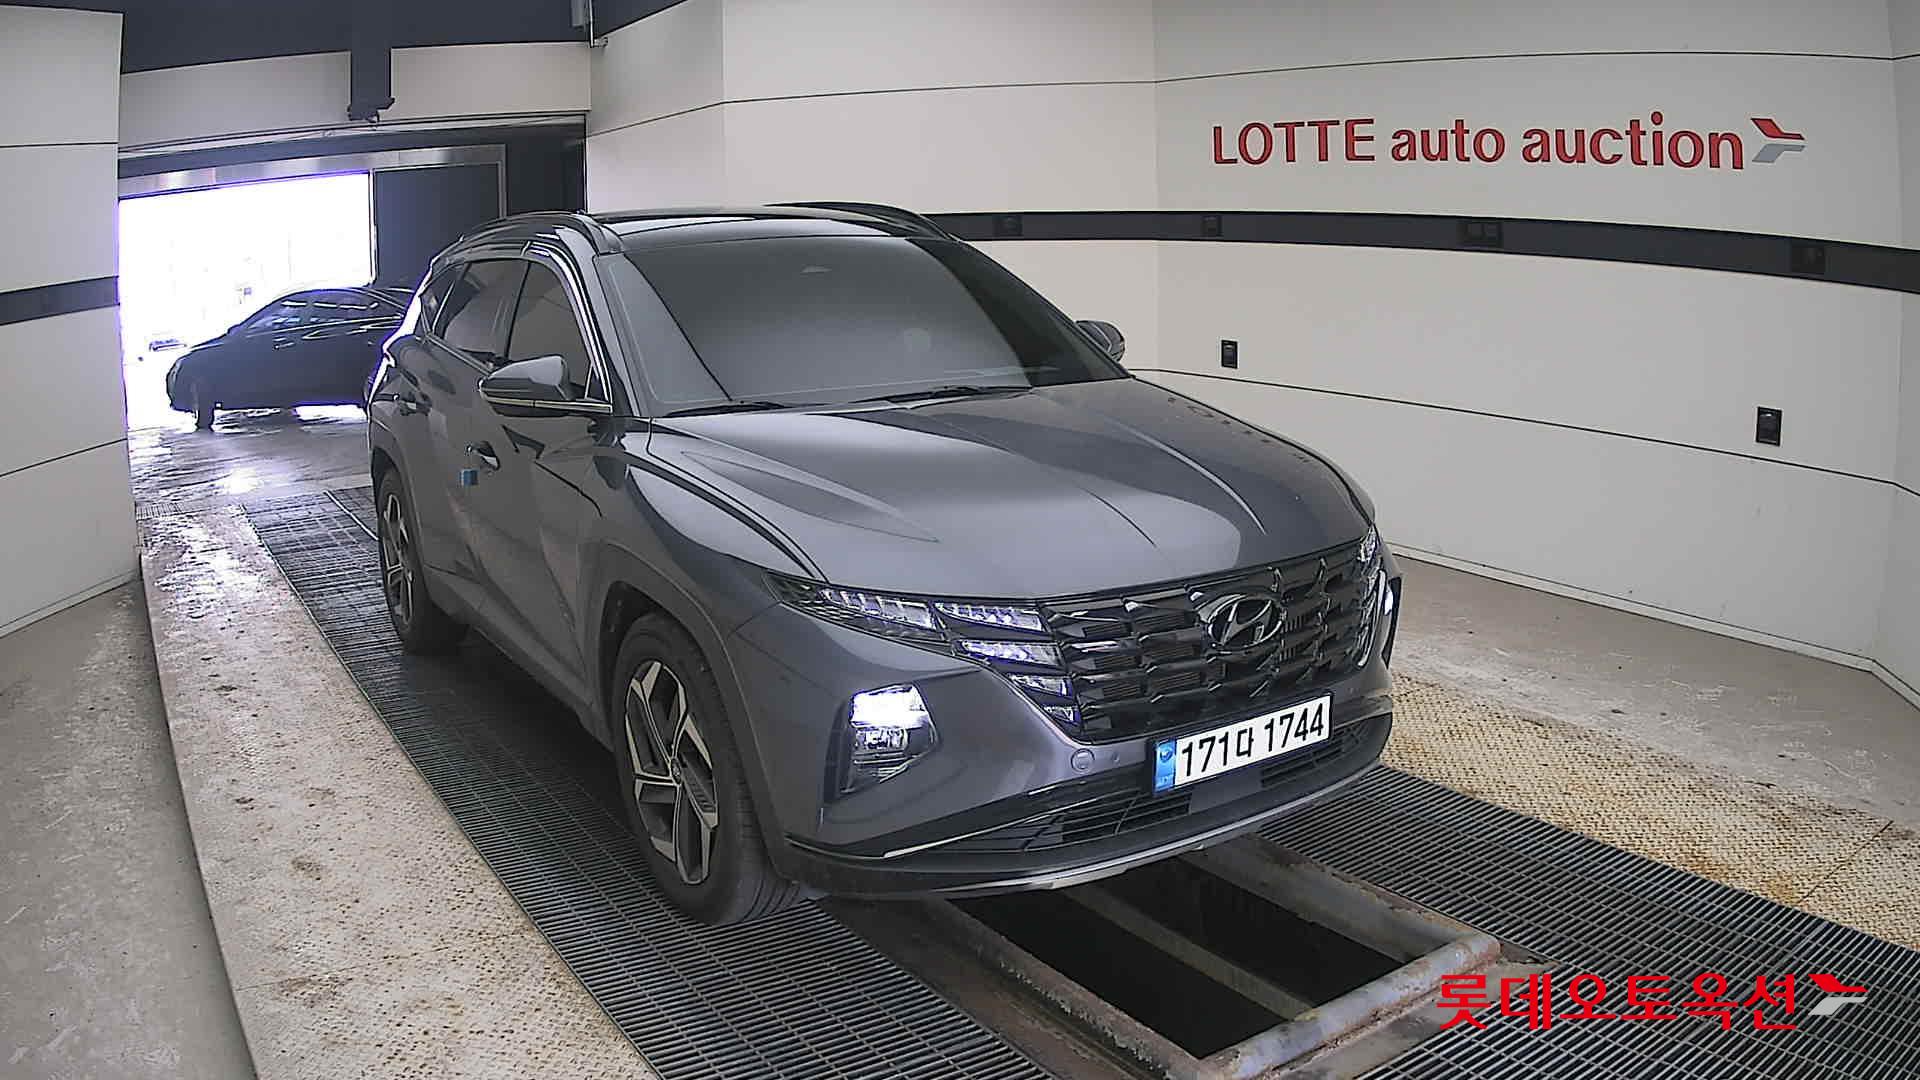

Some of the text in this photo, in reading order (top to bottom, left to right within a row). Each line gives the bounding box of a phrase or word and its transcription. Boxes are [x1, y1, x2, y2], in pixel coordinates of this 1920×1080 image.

[1213, 111, 1745, 170] LOTTE auto auction
[1181, 702, 1324, 777] 171다 1744
